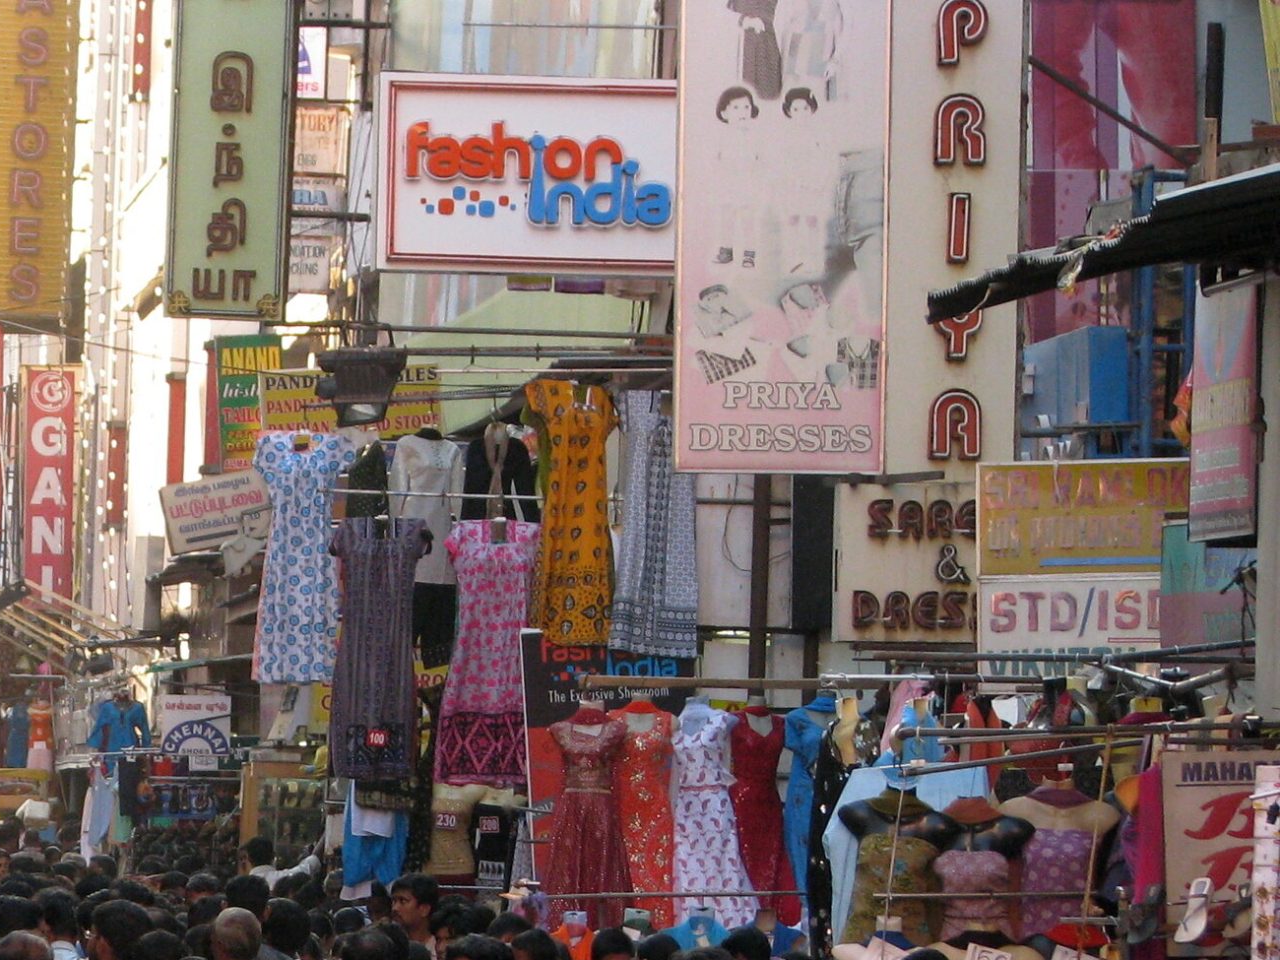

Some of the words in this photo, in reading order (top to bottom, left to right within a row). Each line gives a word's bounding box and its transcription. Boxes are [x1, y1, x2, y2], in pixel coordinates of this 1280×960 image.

[405, 121, 622, 181] fashion
[221, 346, 280, 375] ANAND
[723, 381, 842, 410] PRIYA
[689, 423, 872, 453] DRESSES
[31, 416, 66, 604] GANI
[937, 543, 971, 585] &
[548, 690, 566, 703] The
[165, 724, 226, 752] CHENNAI
[369, 732, 384, 745] 100
[436, 814, 456, 828] 230
